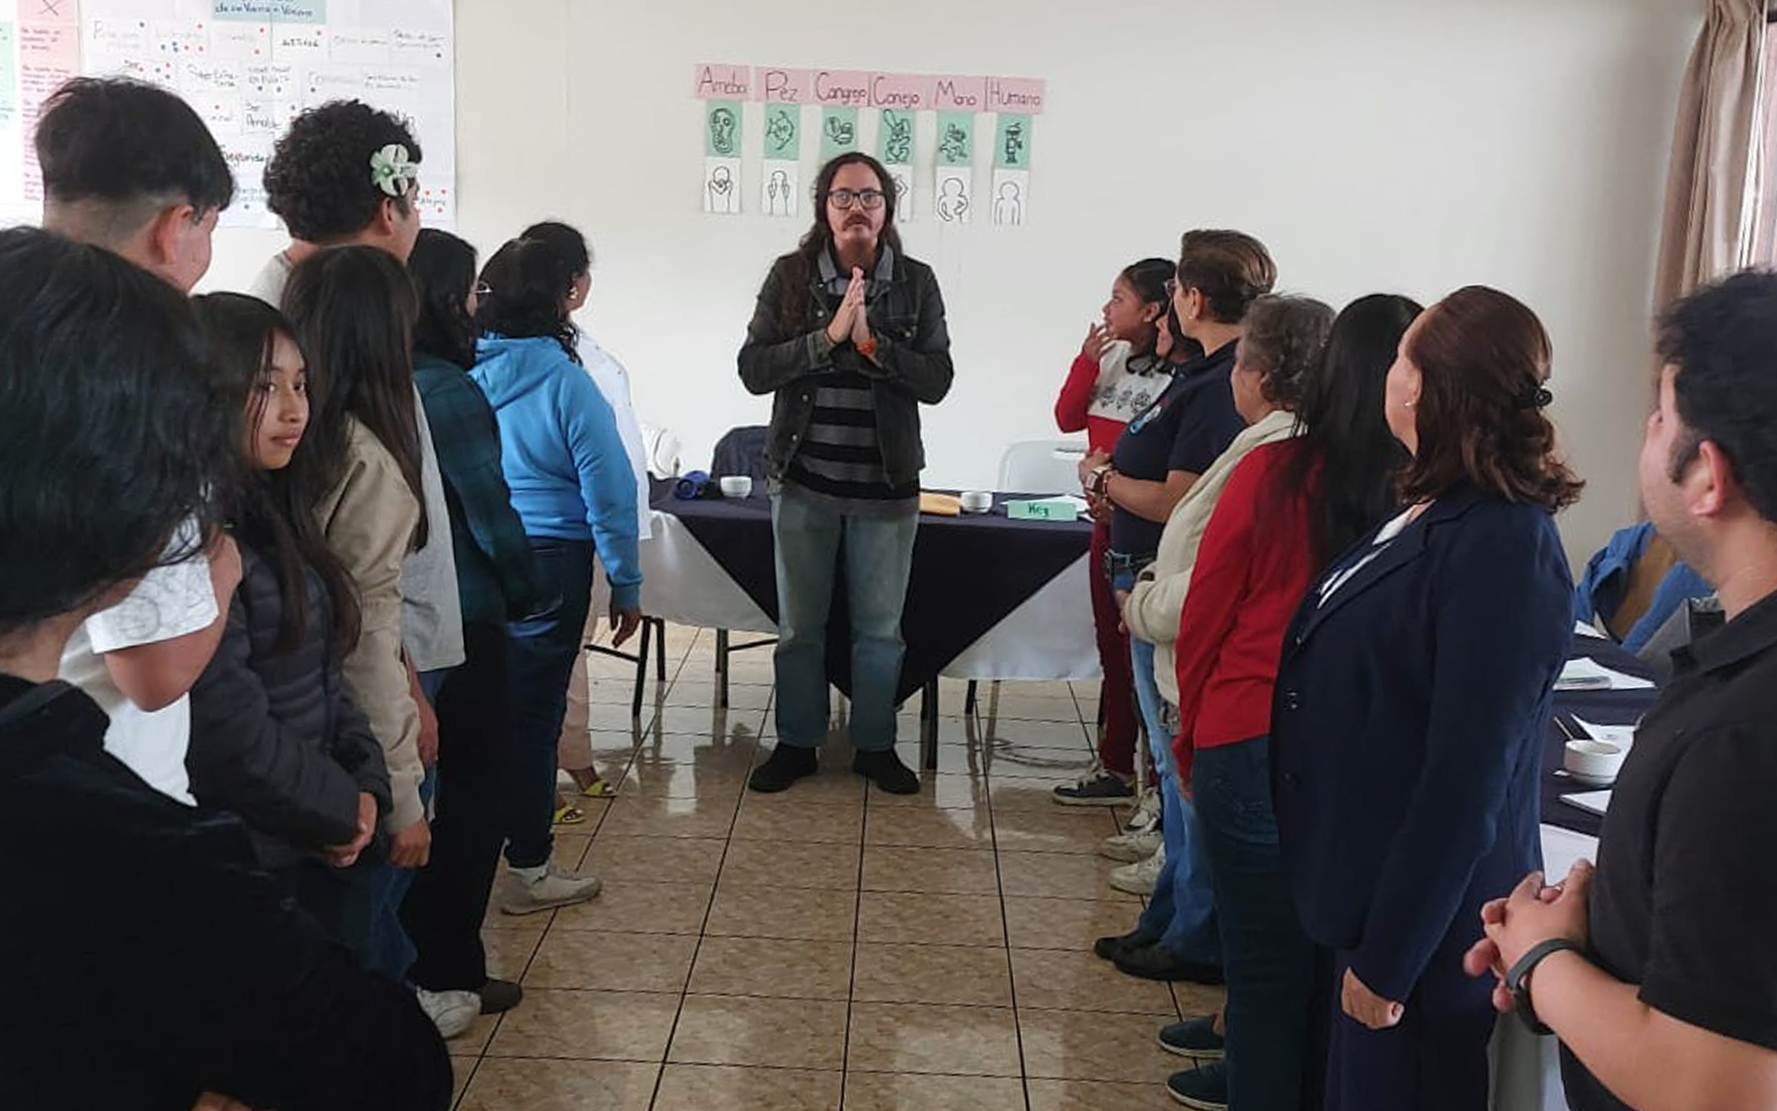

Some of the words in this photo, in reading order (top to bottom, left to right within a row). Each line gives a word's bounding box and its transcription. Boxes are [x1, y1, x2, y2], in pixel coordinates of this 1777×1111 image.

[698, 66, 747, 95] Ameba
[765, 70, 798, 102] Pez
[935, 80, 977, 106] Mono
[989, 80, 1041, 106] Humano
